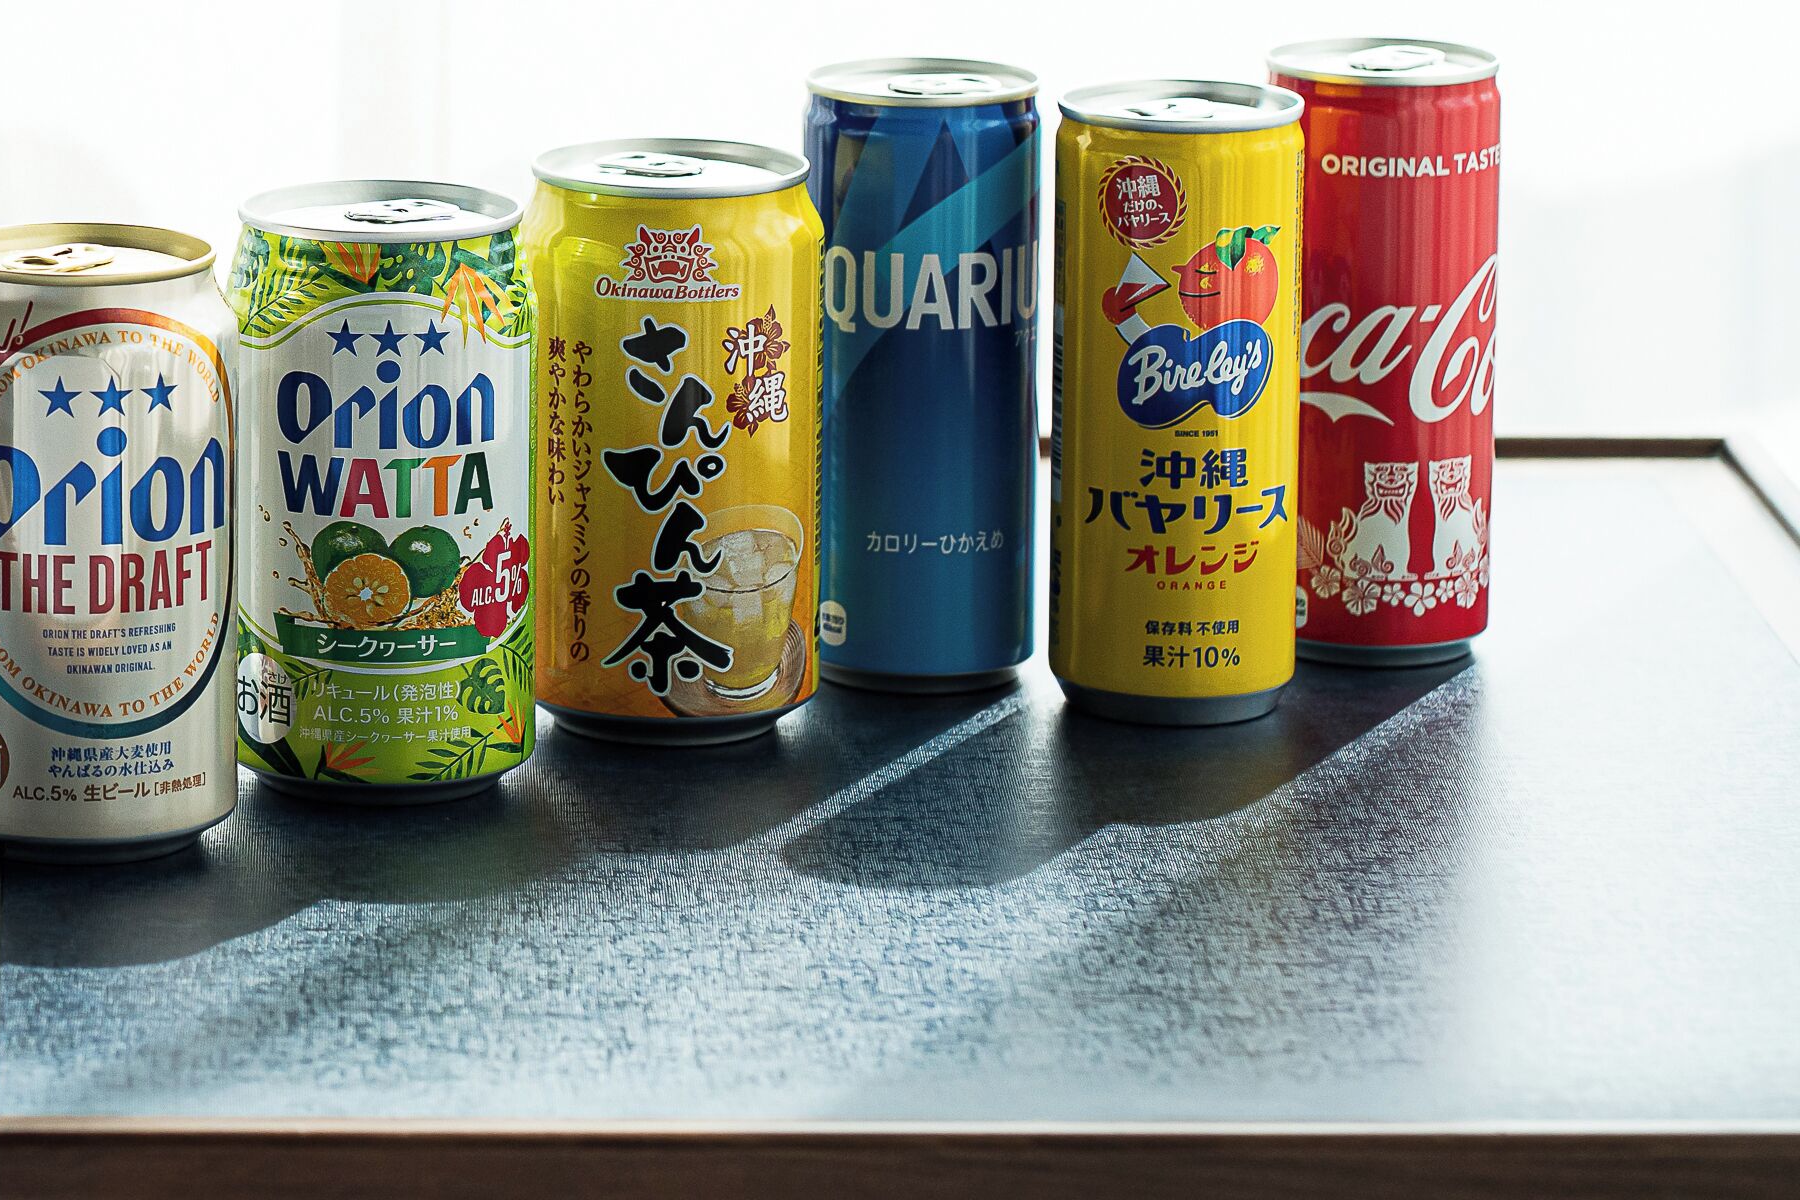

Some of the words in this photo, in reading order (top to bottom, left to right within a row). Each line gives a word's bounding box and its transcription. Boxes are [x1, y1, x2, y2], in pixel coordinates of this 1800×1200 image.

[1321, 153, 1450, 178] ORIGINAL
[1453, 143, 1500, 175] TASTE
[1116, 175, 1161, 200] 沖縄
[824, 240, 1038, 333] QUARIU
[21, 330, 111, 370] OKINAWA
[119, 330, 144, 345] TO
[150, 332, 182, 357] THE
[187, 349, 220, 405] WORLD
[723, 324, 789, 423] 沖縄
[1128, 339, 1262, 406] Bireley's
[547, 336, 568, 506] 爽やかな味わい
[277, 450, 494, 519] WATTA
[1139, 448, 1249, 490] 沖縄
[570, 340, 593, 662] やわらかいジャスミンの香りの
[601, 316, 734, 695] さんぴん茶
[1084, 485, 1289, 535] バヤリース
[866, 528, 1004, 555] カロリーひかえめ
[1125, 541, 1259, 576] オレンジ
[88, 539, 212, 616] DRAFT
[471, 550, 522, 608] ALC.5%
[1157, 579, 1227, 591] ORANGE
[42, 628, 69, 640] ORION
[72, 628, 87, 640] THE
[90, 628, 126, 640] DRAFT'S
[128, 622, 176, 638] REFRESHING
[48, 646, 74, 658] TASTE
[76, 646, 85, 657] IS
[88, 646, 119, 657] WIDELY
[121, 643, 148, 656] LOVED
[150, 641, 160, 653] AS
[162, 640, 172, 651] AN
[21, 676, 113, 718] OKINAWA
[119, 699, 145, 717] TO
[149, 676, 185, 708] THE
[184, 611, 220, 678] WORLD
[66, 663, 113, 675] OKINAWAN
[1143, 646, 1241, 669] 果汁10%
[238, 675, 292, 728] お酒
[313, 705, 389, 724] ALC.5%
[396, 705, 459, 724] 果汁1%
[47, 758, 175, 778] やんばるの水仕込み
[51, 741, 172, 762] 沖縄県産大麦使用
[13, 785, 78, 802] ALC.5%
[83, 781, 151, 802] 生ビール
